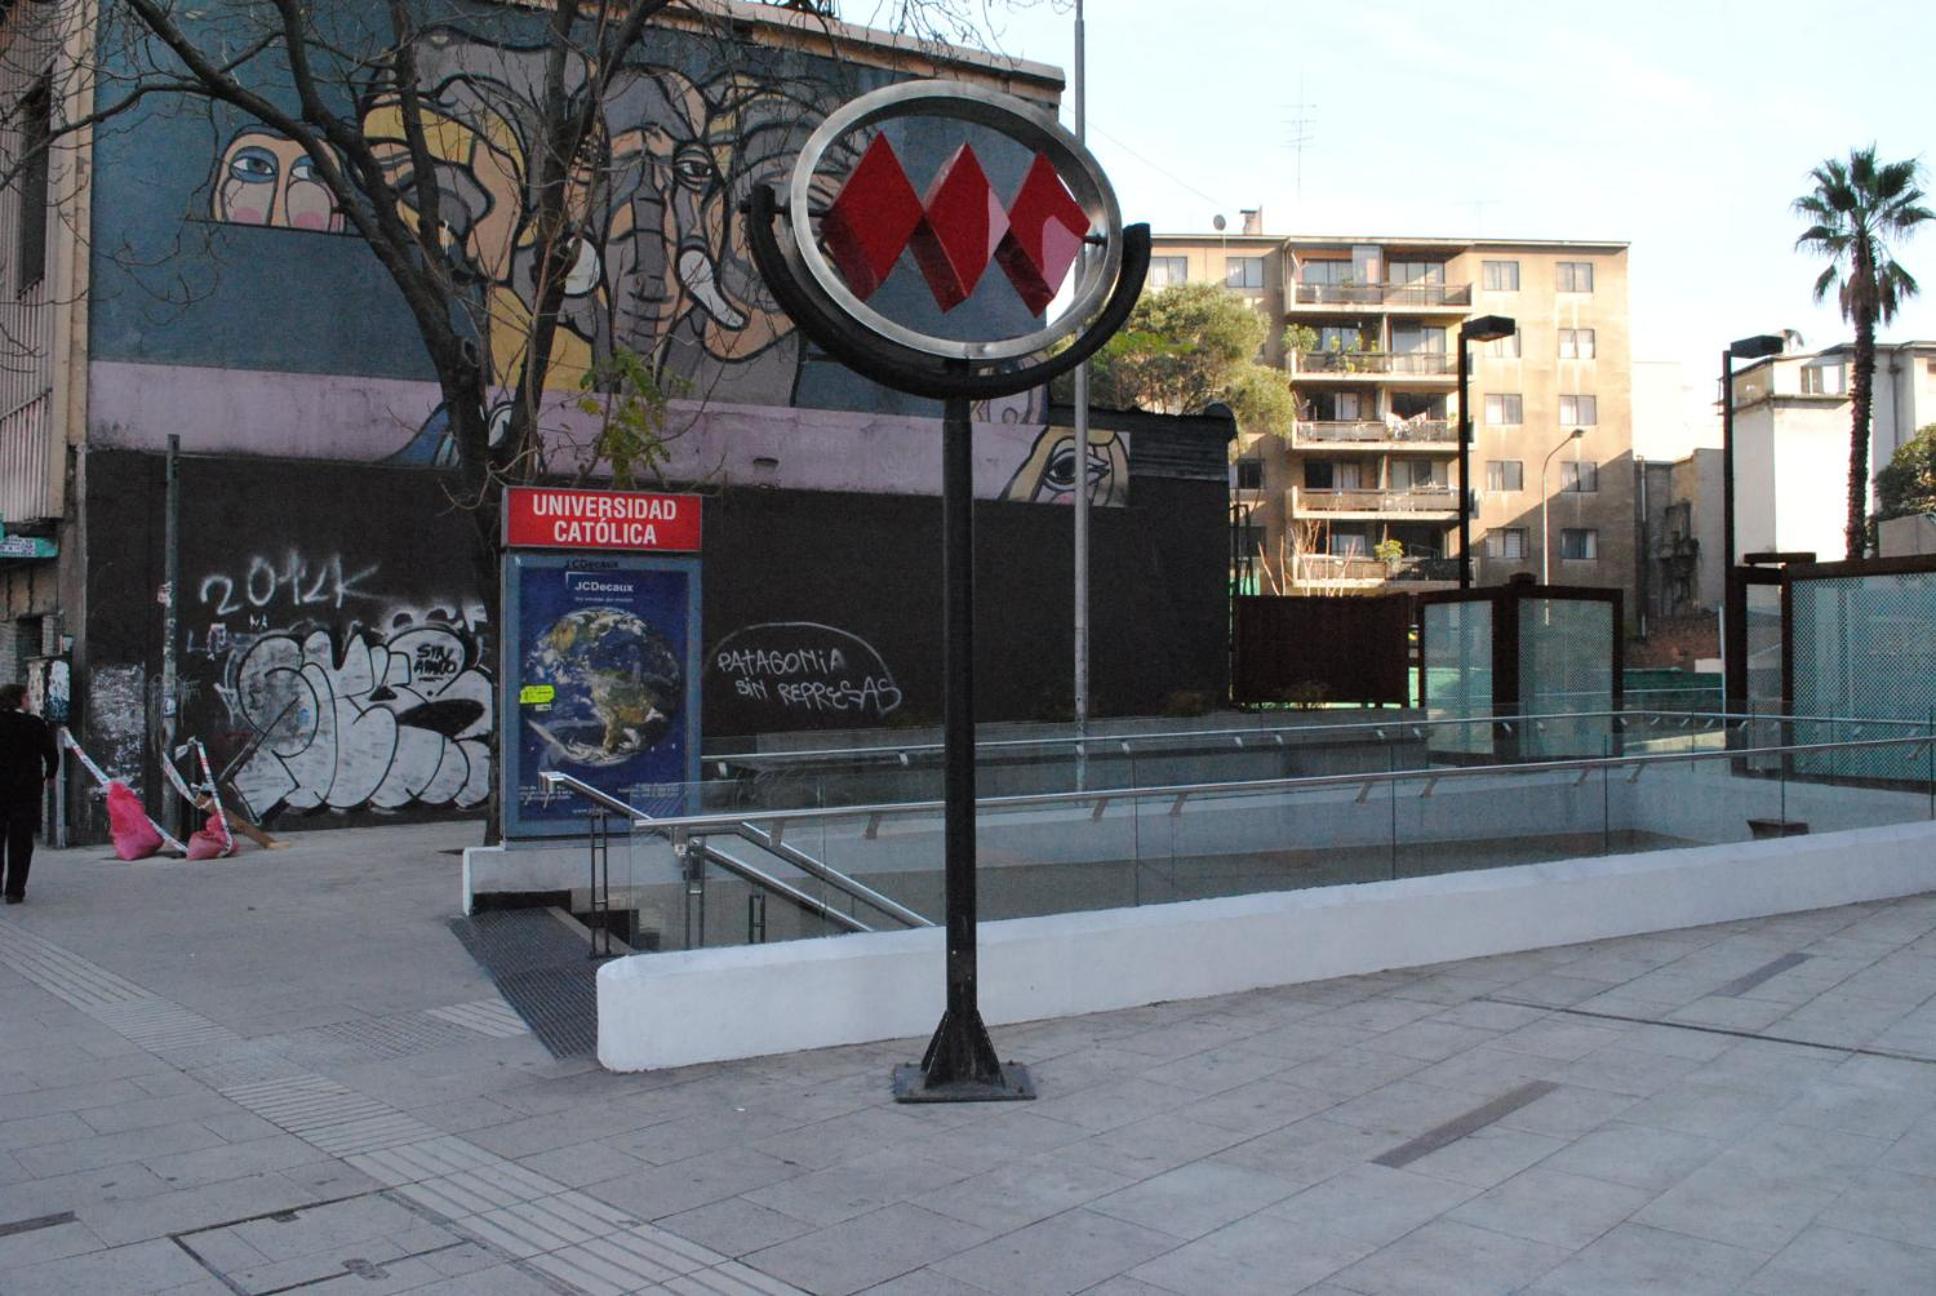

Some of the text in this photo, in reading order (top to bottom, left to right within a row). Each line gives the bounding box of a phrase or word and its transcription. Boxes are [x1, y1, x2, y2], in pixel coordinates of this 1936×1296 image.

[533, 494, 676, 520] UNIVERSIDAD
[554, 518, 657, 545] CATÓLICA
[574, 581, 634, 592] JCDecaux
